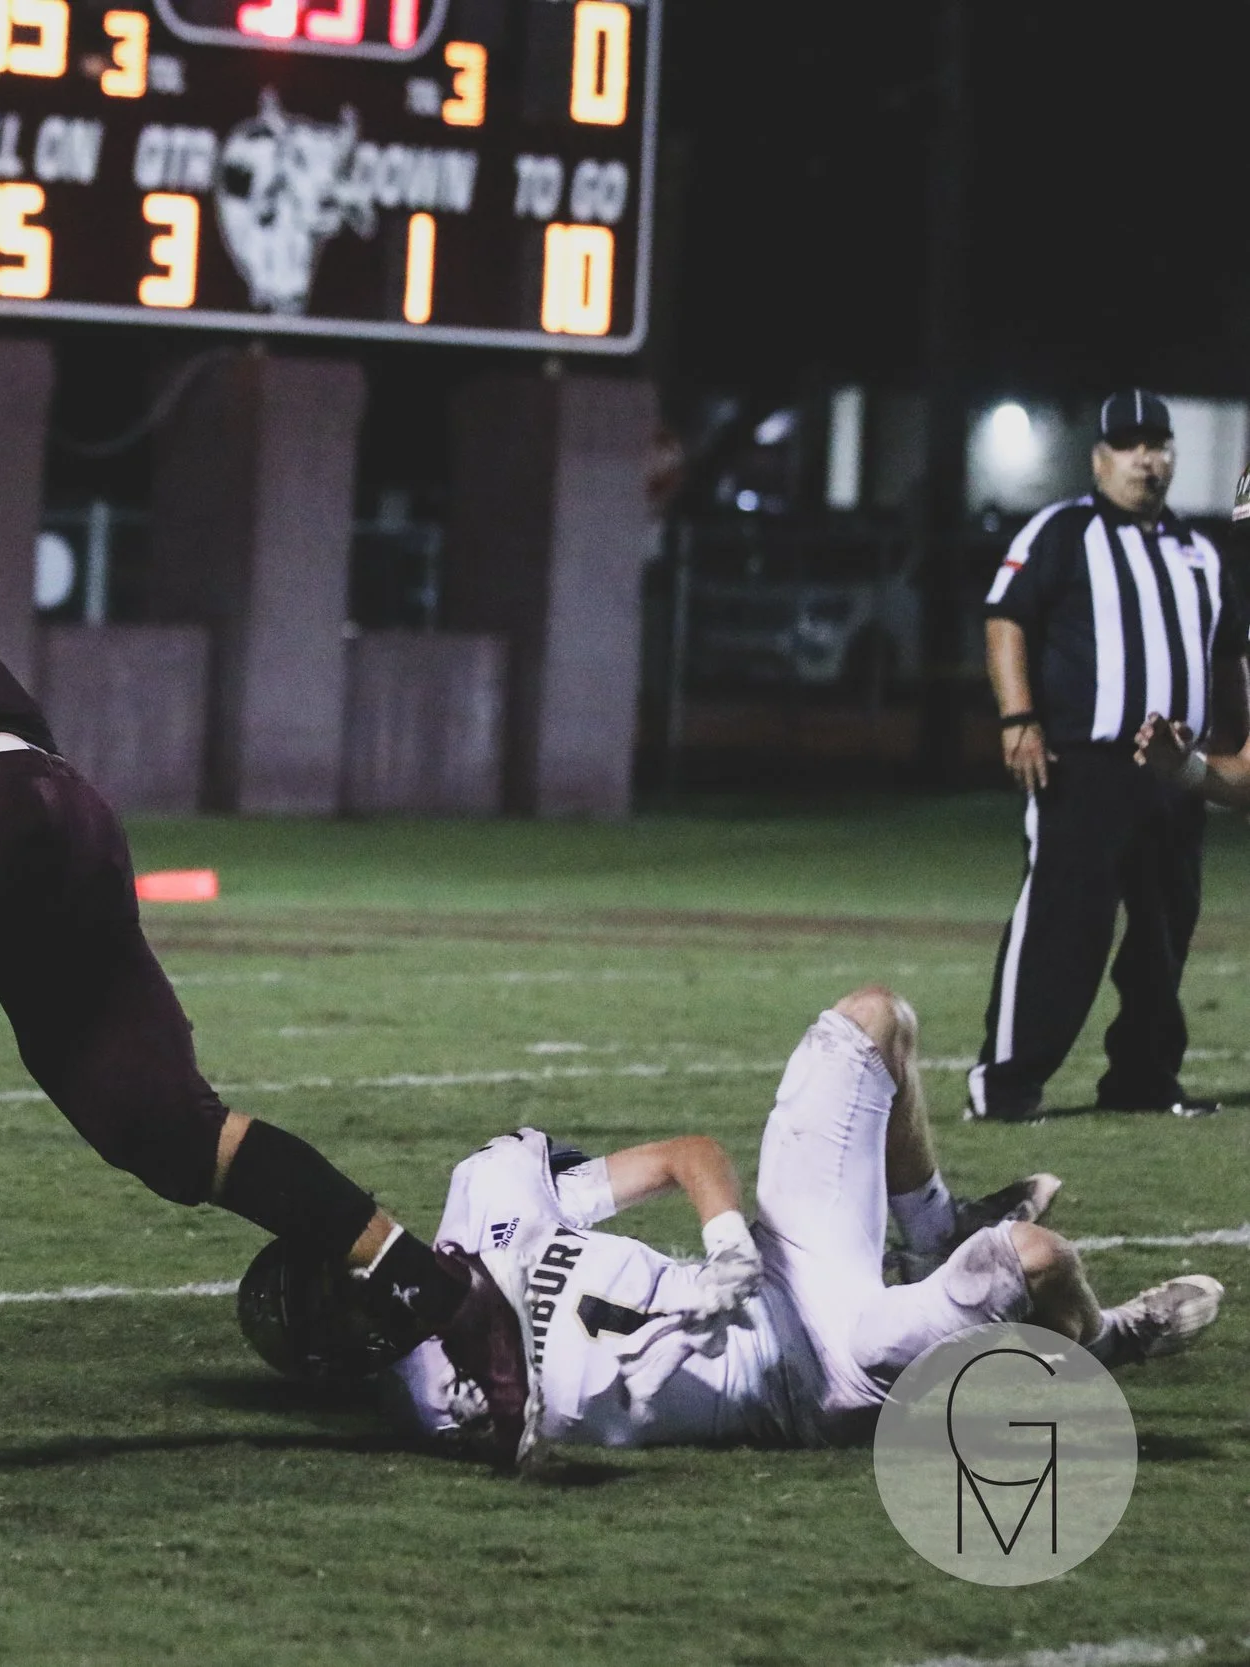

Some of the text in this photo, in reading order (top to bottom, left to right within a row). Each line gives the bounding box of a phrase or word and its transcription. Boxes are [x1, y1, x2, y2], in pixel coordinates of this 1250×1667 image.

[101, 9, 150, 98] 3
[442, 41, 488, 127] 3
[570, 1, 630, 126] 0
[35, 113, 103, 187] ON
[513, 152, 629, 226] TO GO
[138, 192, 200, 309] 3
[403, 212, 437, 325] 1
[541, 221, 615, 336] 10
